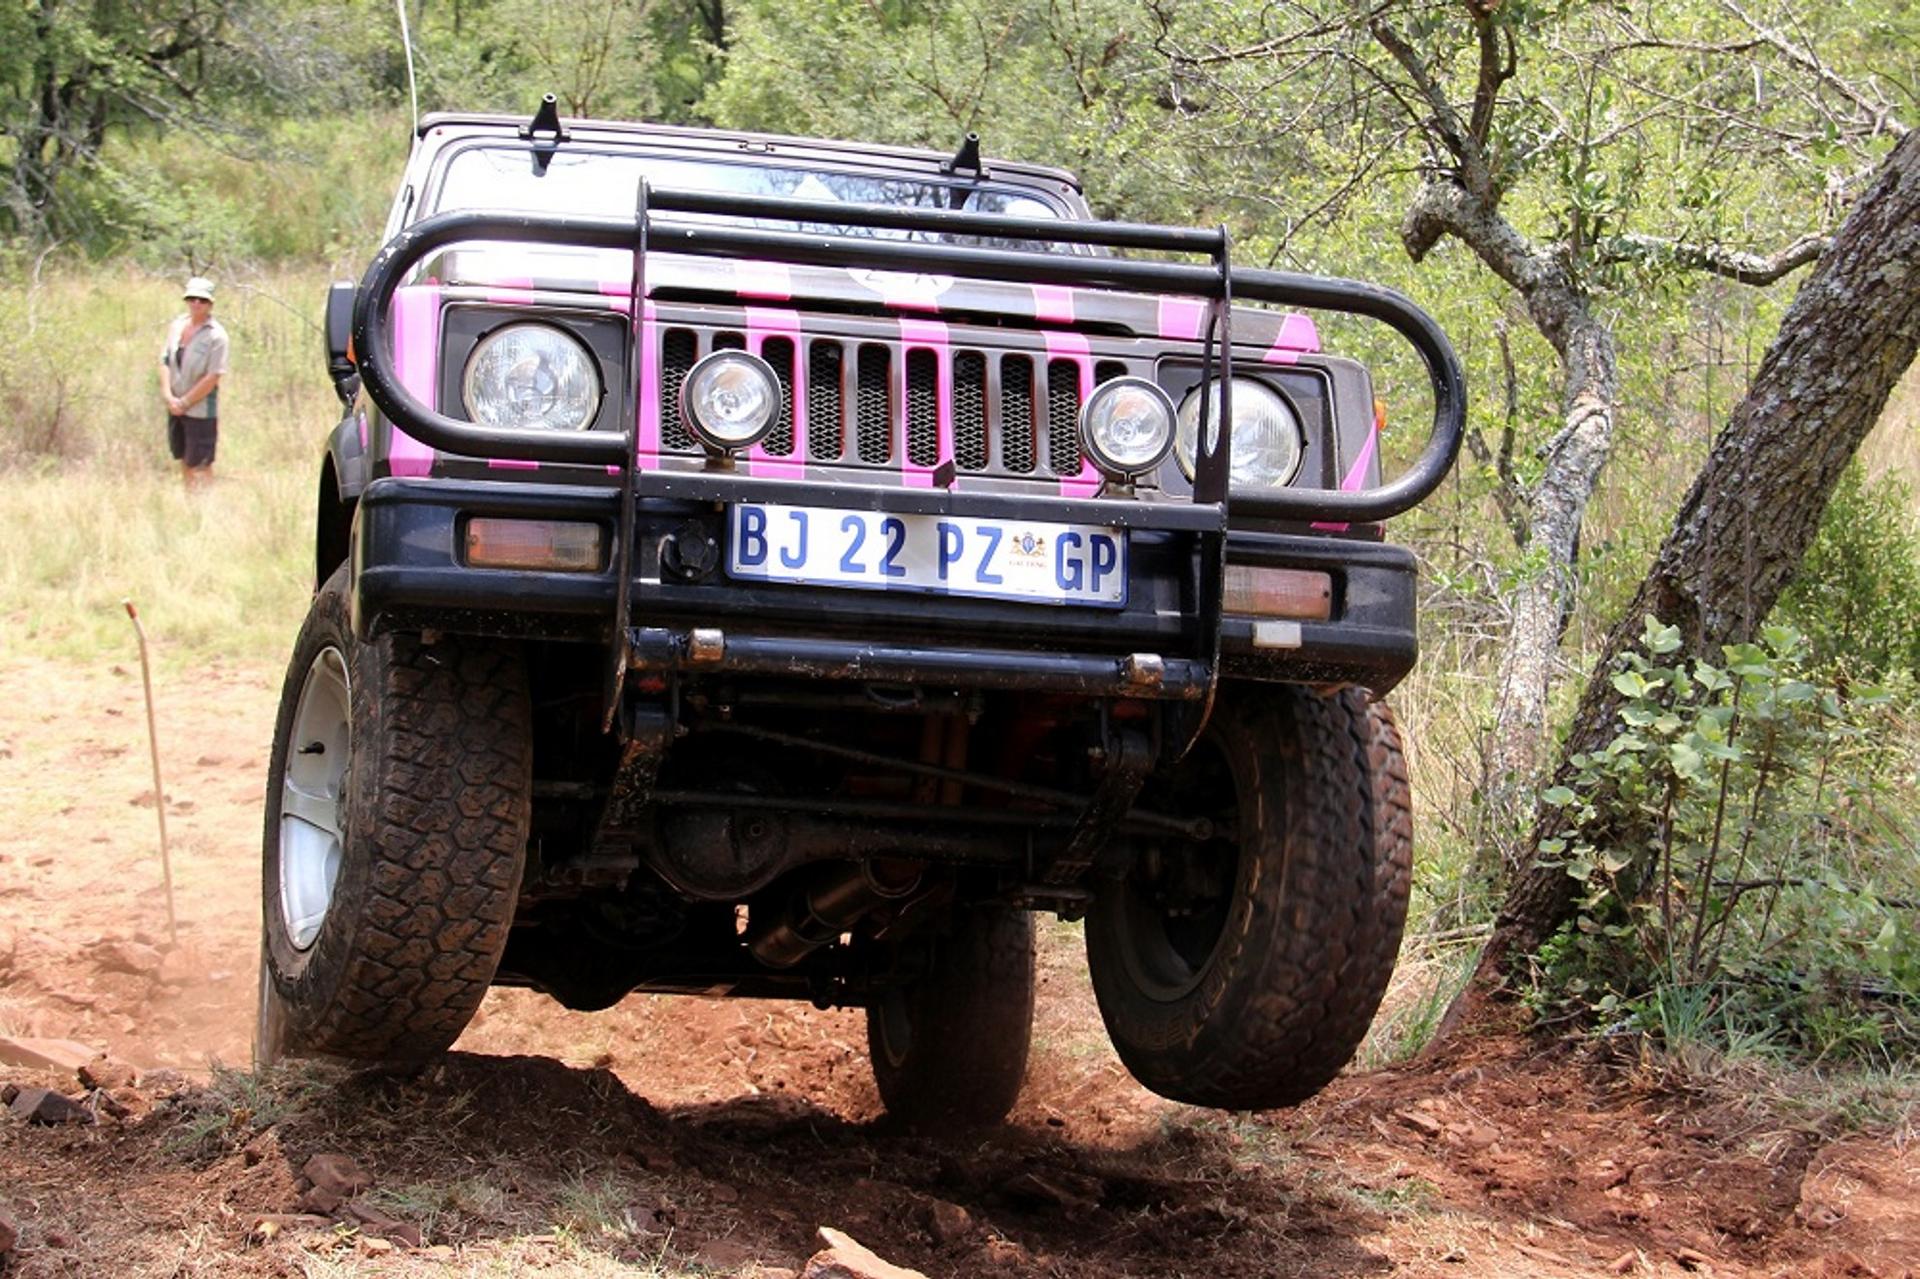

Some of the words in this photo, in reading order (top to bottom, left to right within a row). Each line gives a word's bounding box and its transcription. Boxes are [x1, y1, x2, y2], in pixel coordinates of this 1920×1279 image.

[739, 506, 808, 568] BJ
[839, 514, 907, 577] 22
[936, 521, 1004, 585] PZ
[1055, 532, 1117, 593] GP
